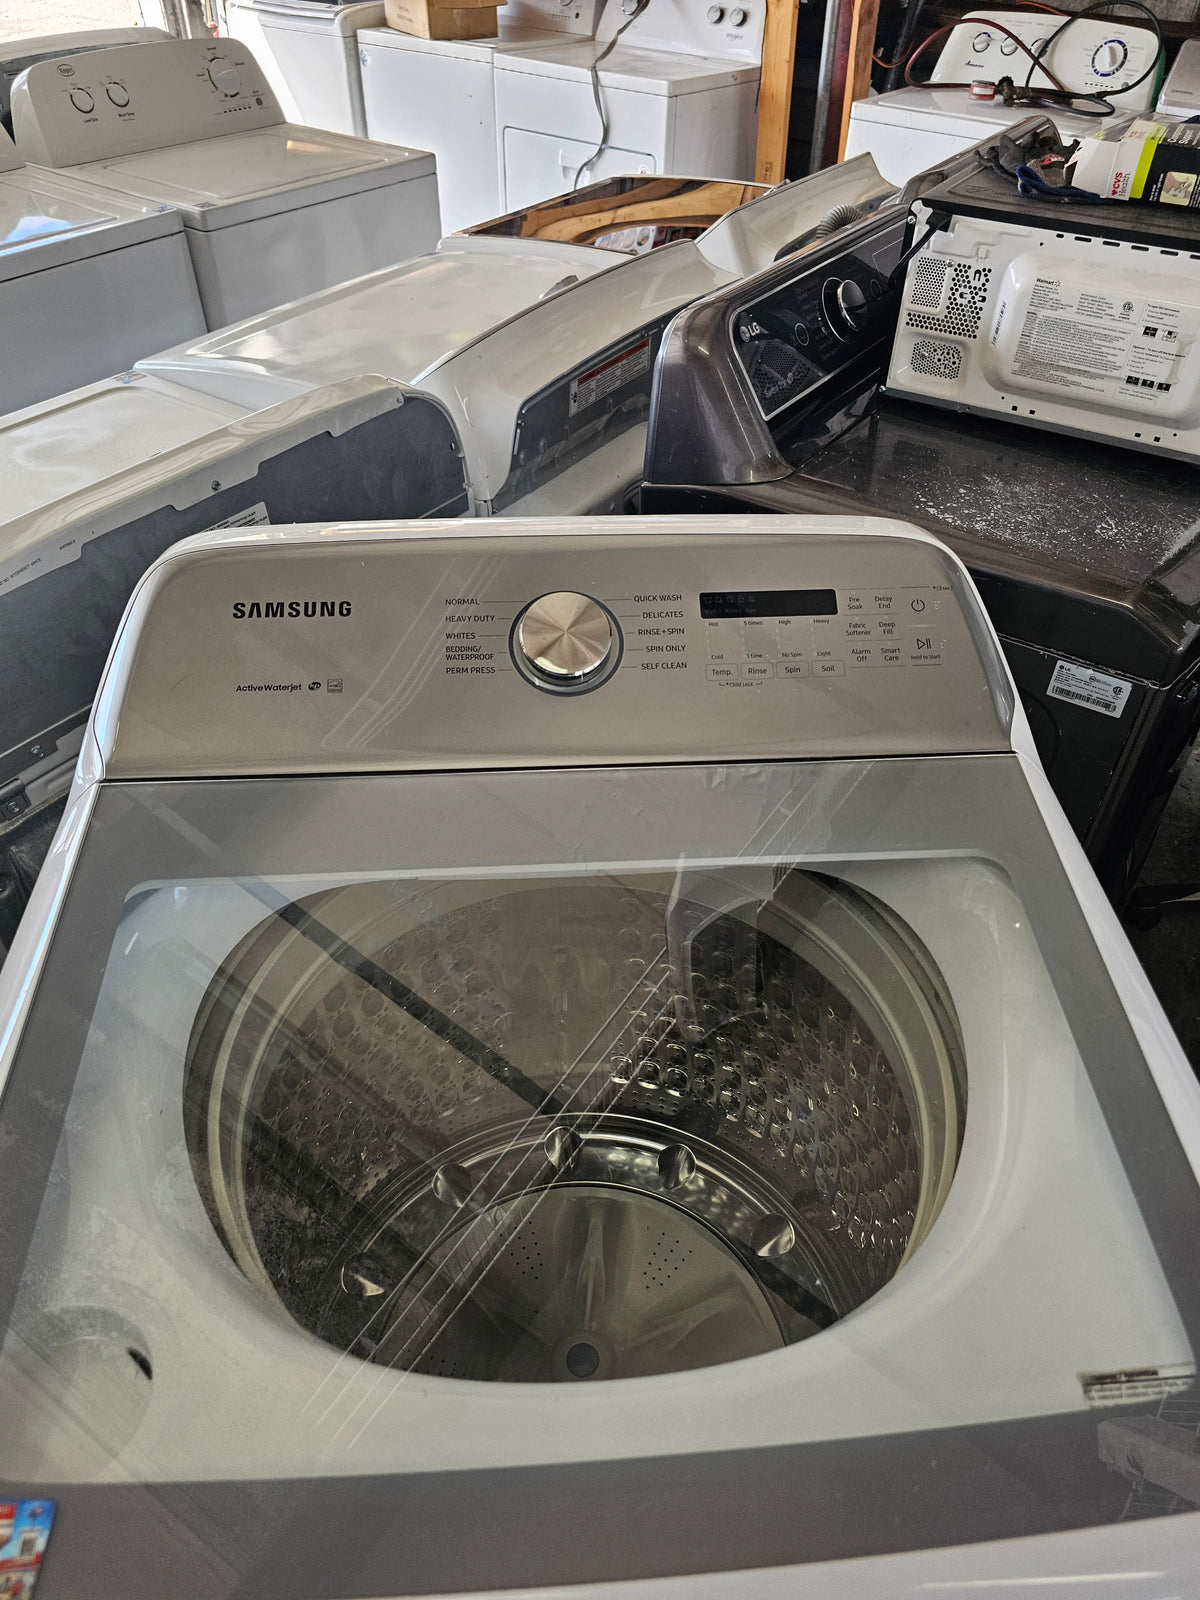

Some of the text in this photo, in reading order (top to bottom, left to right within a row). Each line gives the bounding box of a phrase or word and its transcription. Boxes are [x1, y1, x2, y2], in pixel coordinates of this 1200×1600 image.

[1112, 172, 1123, 190] CVS
[1118, 173, 1130, 196] Health
[748, 322, 760, 336] LG
[445, 598, 480, 606] NORMAL
[634, 594, 682, 603] QUICK WASH
[232, 601, 352, 619] SAMSUNG
[642, 611, 684, 619] DELICATES
[878, 622, 896, 630] Deep
[445, 632, 476, 640] WHITES
[445, 645, 481, 653] BEDDING/
[445, 653, 494, 661] WATERPROOF
[470, 666, 496, 674] PRESS
[641, 662, 688, 670] SELF CLEAN
[785, 666, 801, 674] Spin
[712, 668, 734, 676] Temp.
